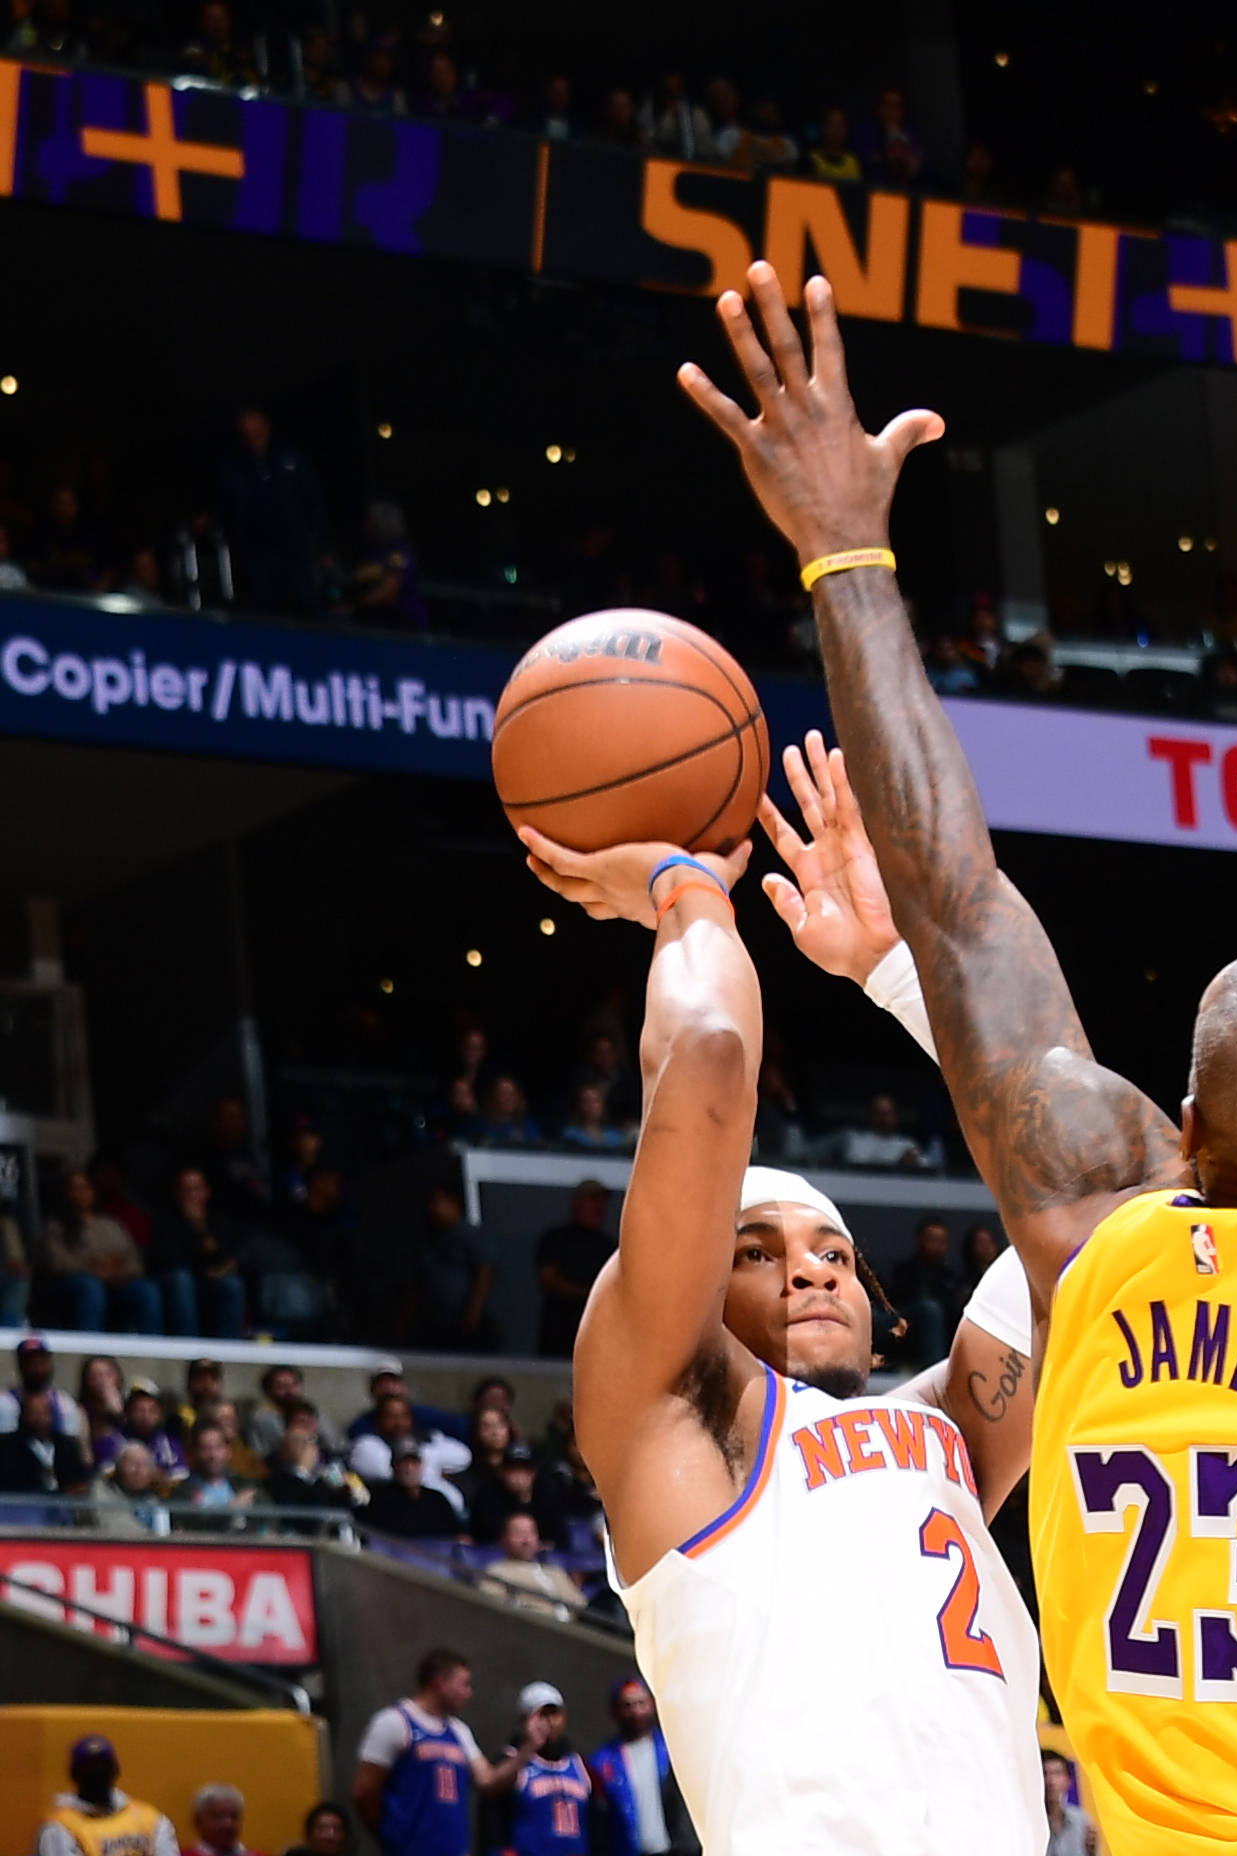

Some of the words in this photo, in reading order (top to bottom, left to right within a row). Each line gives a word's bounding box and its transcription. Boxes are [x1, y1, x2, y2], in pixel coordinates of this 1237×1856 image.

[791, 1407, 928, 1492] NEW
[5, 1559, 306, 1651] SHIBA
[919, 1506, 1006, 1680] 2
